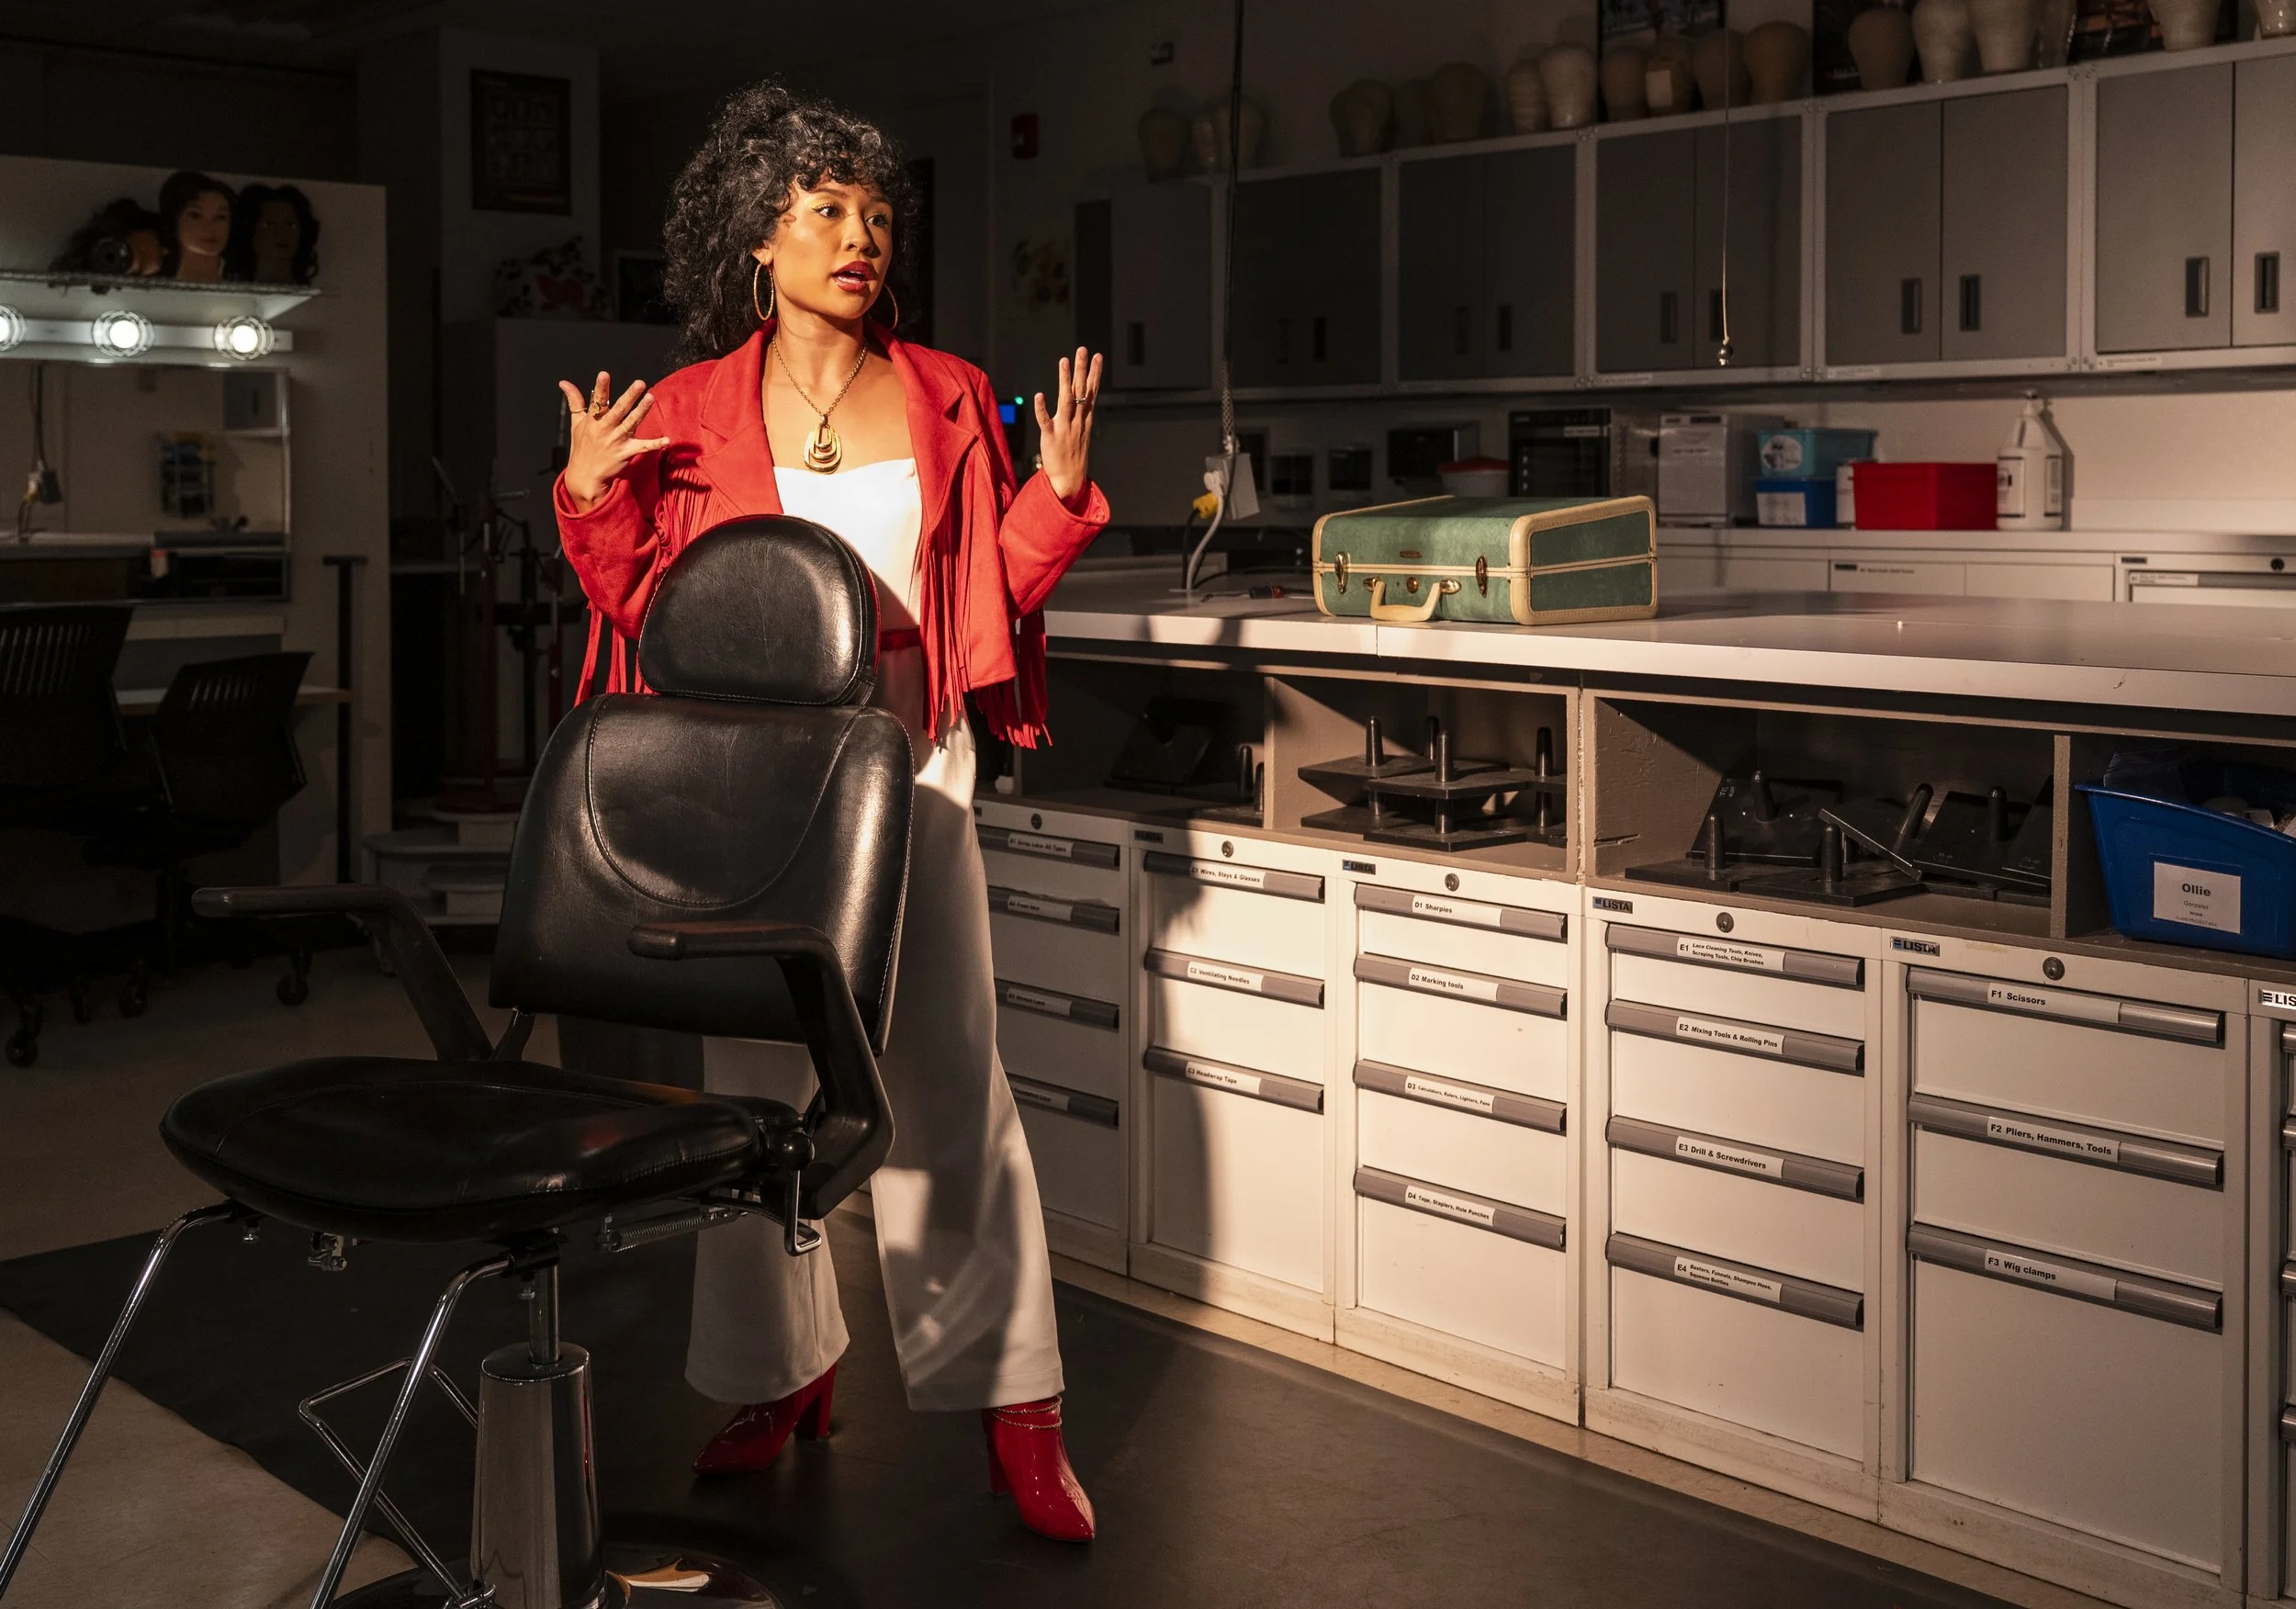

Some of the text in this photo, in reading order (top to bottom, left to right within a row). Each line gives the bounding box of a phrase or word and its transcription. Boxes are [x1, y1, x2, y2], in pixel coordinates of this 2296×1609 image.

[1200, 868, 1217, 876] Wires,
[1218, 871, 1232, 879] Stays
[1240, 874, 1260, 883] Glasses
[2182, 883, 2212, 896] Ollie
[1425, 903, 1453, 913] Sharpies
[1603, 899, 1631, 911] LISTA
[1705, 945, 1727, 953] Cleaning
[1903, 940, 1936, 954] LISTA
[1693, 951, 1714, 959] Scraping
[1199, 969, 1227, 981] Ventilating
[1228, 975, 1250, 984] Needles
[1422, 976, 1446, 987] Marking
[1991, 990, 2046, 1006] F1 Scissors
[1692, 1027, 1712, 1036] Mixing
[1714, 1030, 1730, 1039] Tools
[1739, 1036, 1762, 1046] Rolling
[1197, 1069, 1222, 1081] Headwrap
[1418, 1086, 1443, 1096] Calculators,
[1991, 1124, 2111, 1155] F2 Pliers, Hammers, Tools
[1679, 1143, 1688, 1152] E3
[1691, 1146, 1706, 1155] Drill
[1716, 1152, 1766, 1169] Screwdrivers
[1418, 1196, 1432, 1204] Tape,
[1433, 1199, 1455, 1210] Staplers,
[1468, 1210, 1490, 1220] Punches
[1677, 1264, 1687, 1272] E4
[1733, 1276, 1756, 1286] Shampoo
[1988, 1257, 2056, 1280] F3 Wig clamps
